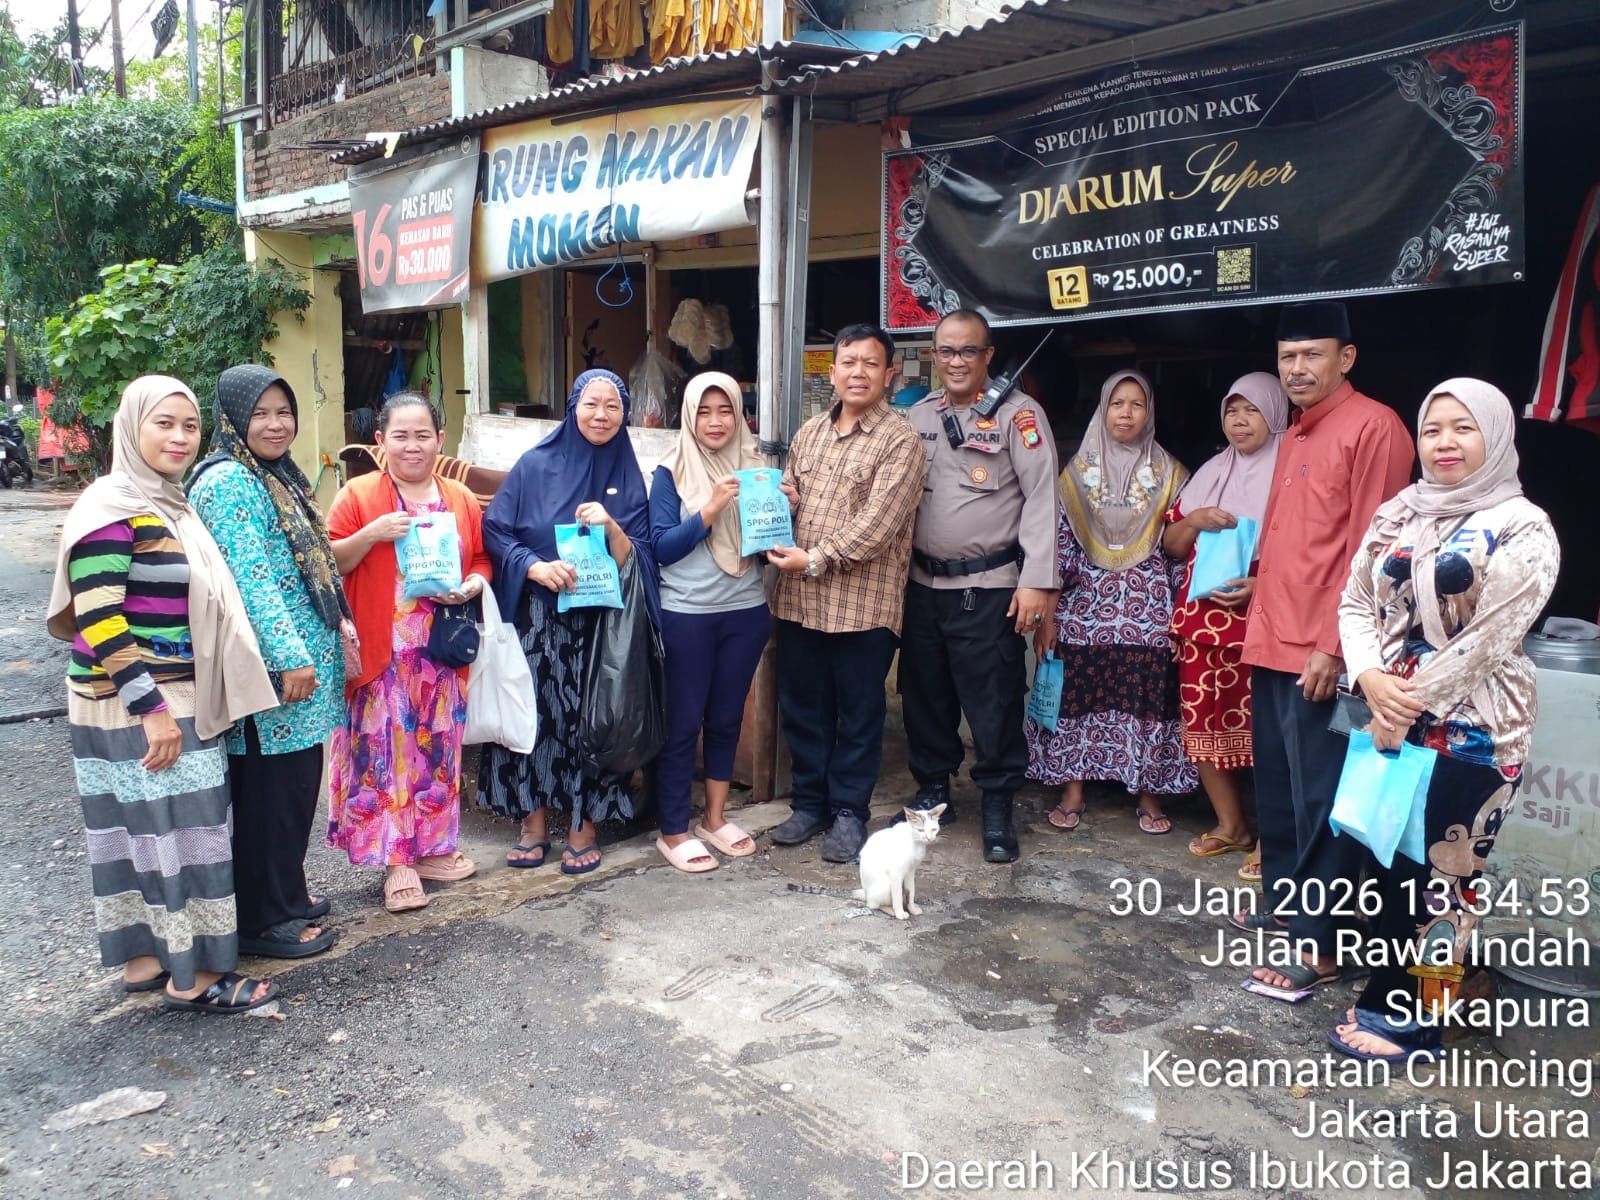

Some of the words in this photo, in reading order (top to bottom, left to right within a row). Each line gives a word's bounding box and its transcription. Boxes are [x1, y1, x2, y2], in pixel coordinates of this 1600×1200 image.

[1053, 96, 1091, 111] MEMBERI
[1124, 79, 1152, 92] ORANG
[1163, 70, 1189, 84] BAWAH
[1034, 121, 1108, 154] SPECIAL
[1113, 103, 1199, 136] EDITION
[1205, 93, 1262, 120] PACK
[475, 135, 588, 203] ARUNG
[596, 115, 749, 189] MAKAN
[1018, 165, 1164, 225] DJARUM
[1169, 140, 1297, 212] Super
[401, 196, 418, 220] PAS
[419, 195, 427, 216] &
[428, 187, 453, 215] PUAS
[1032, 231, 1141, 260] CELEBRATION
[1145, 227, 1165, 245] OF
[1170, 214, 1280, 241] GREATNESS
[1465, 212, 1501, 234] #INI
[353, 202, 393, 289] 16
[1443, 225, 1511, 255] RASANYA
[1453, 245, 1510, 271] SUPER
[1055, 273, 1081, 297] 12
[967, 432, 1000, 443] POLRI
[747, 518, 770, 527] SPPG
[586, 571, 612, 582] POLRI
[1522, 800, 1571, 829] Saji
